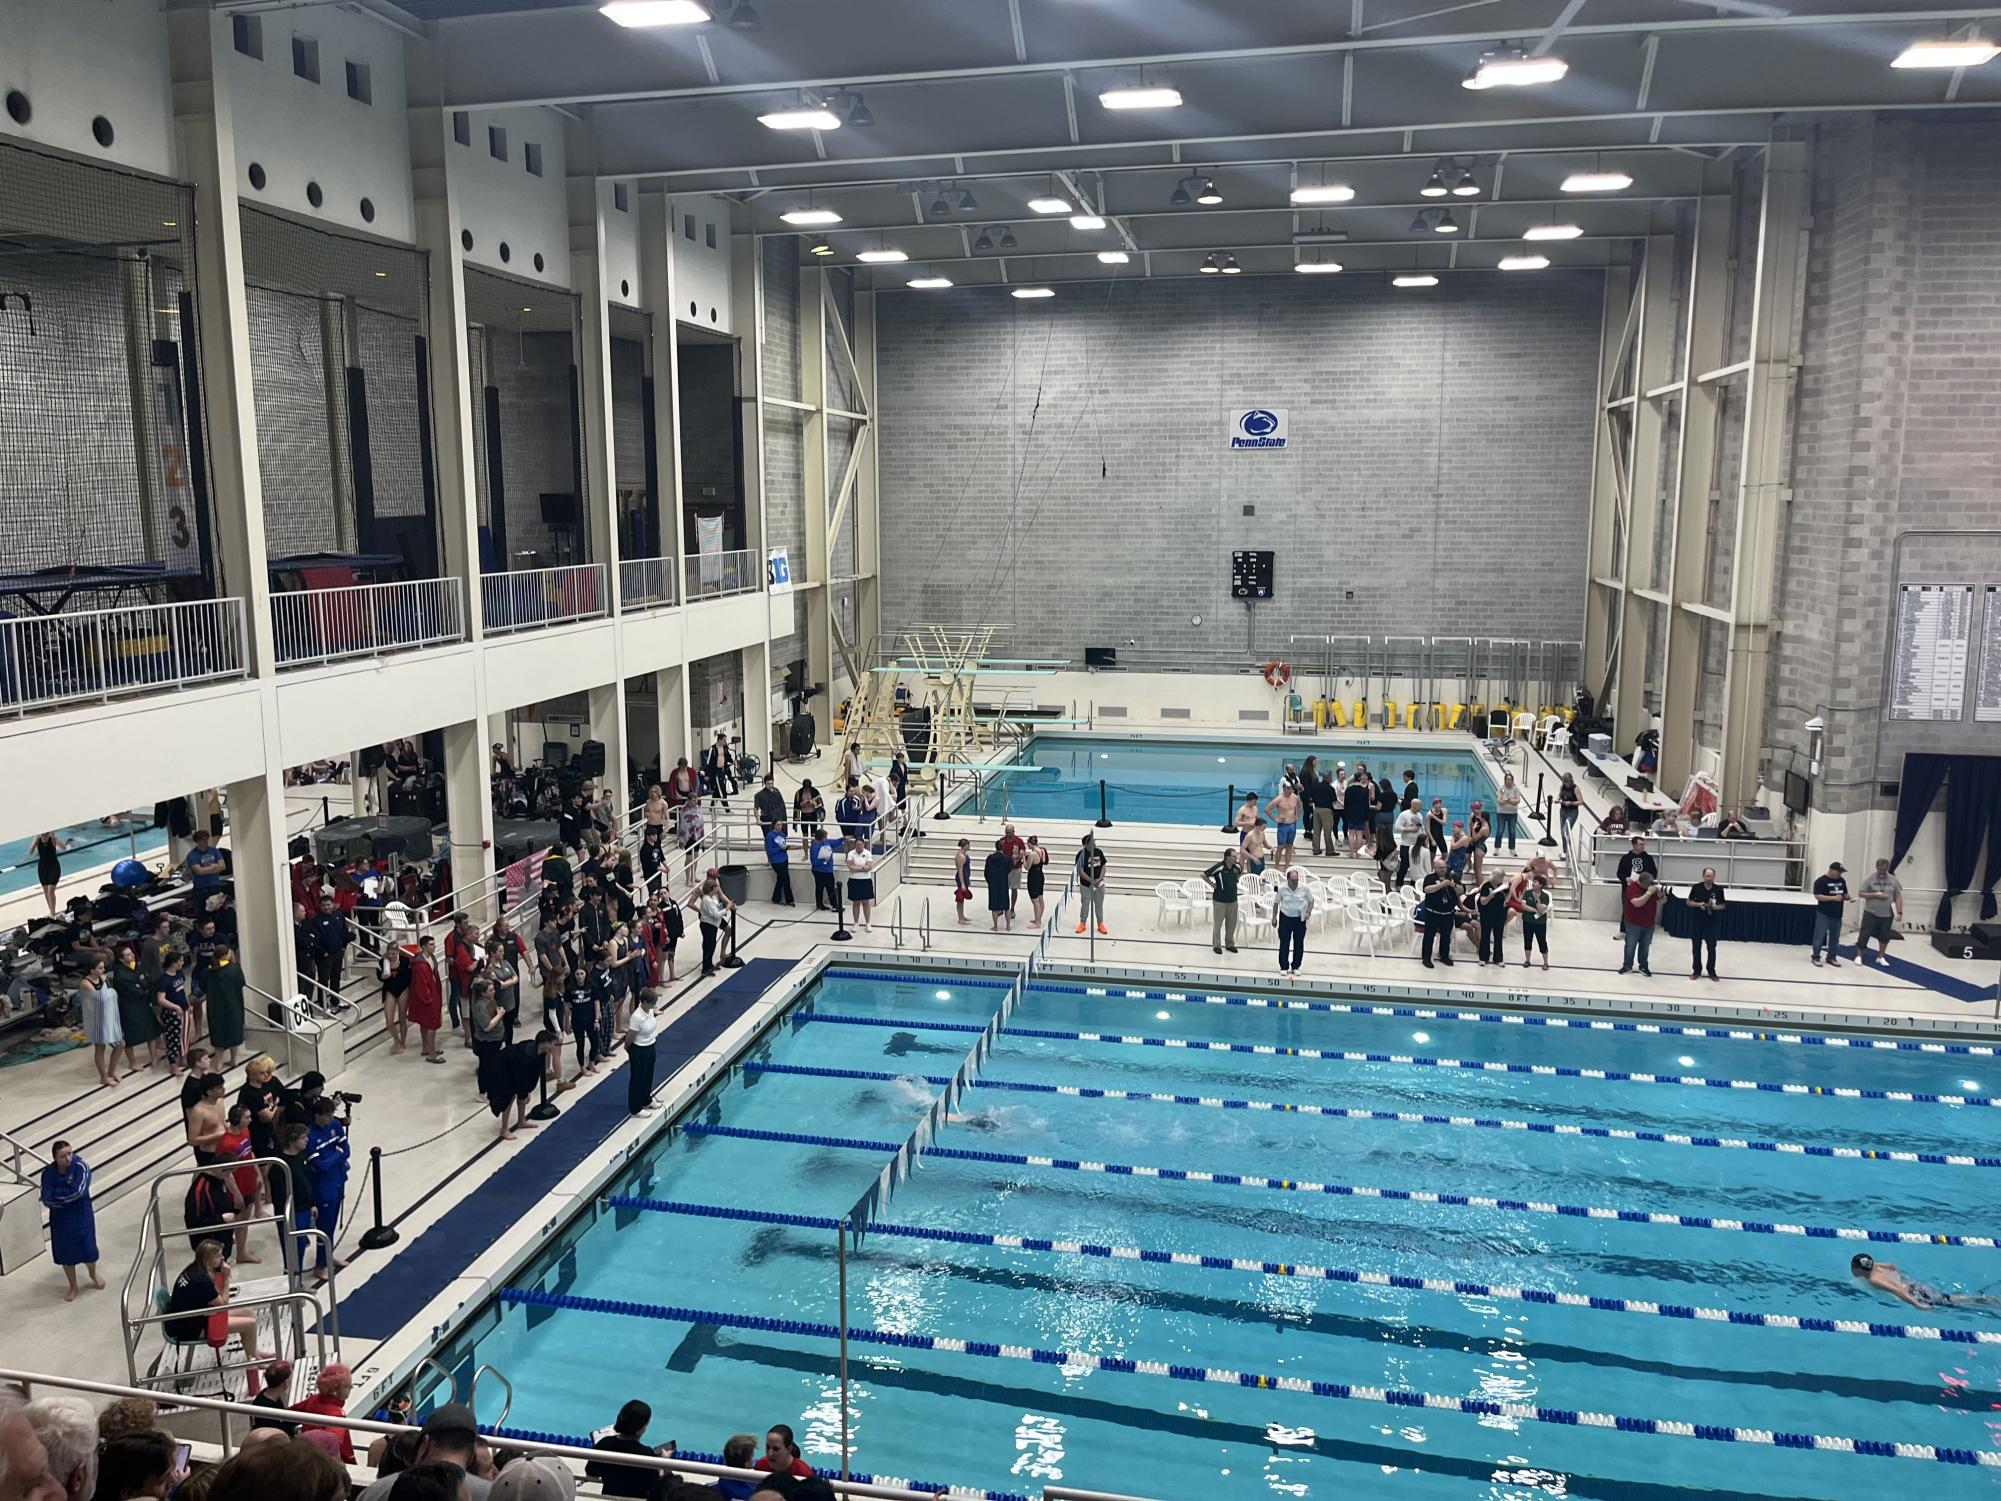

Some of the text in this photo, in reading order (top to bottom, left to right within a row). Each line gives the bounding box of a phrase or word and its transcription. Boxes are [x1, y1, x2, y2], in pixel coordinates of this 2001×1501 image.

[163, 445, 186, 488] 2
[169, 506, 190, 549] 3
[1632, 857, 1643, 872] S
[1963, 946, 1974, 959] 5
[909, 956, 921, 964] 70
[1083, 966, 1096, 974] 60
[1174, 972, 1187, 980] 55
[1267, 979, 1280, 987] 50
[1363, 985, 1376, 993] 45
[1461, 991, 1475, 999] 40
[1563, 997, 1576, 1005] 35
[1666, 1004, 1680, 1012] 30
[1774, 1011, 1788, 1019] 25
[1883, 1018, 1897, 1026] 20
